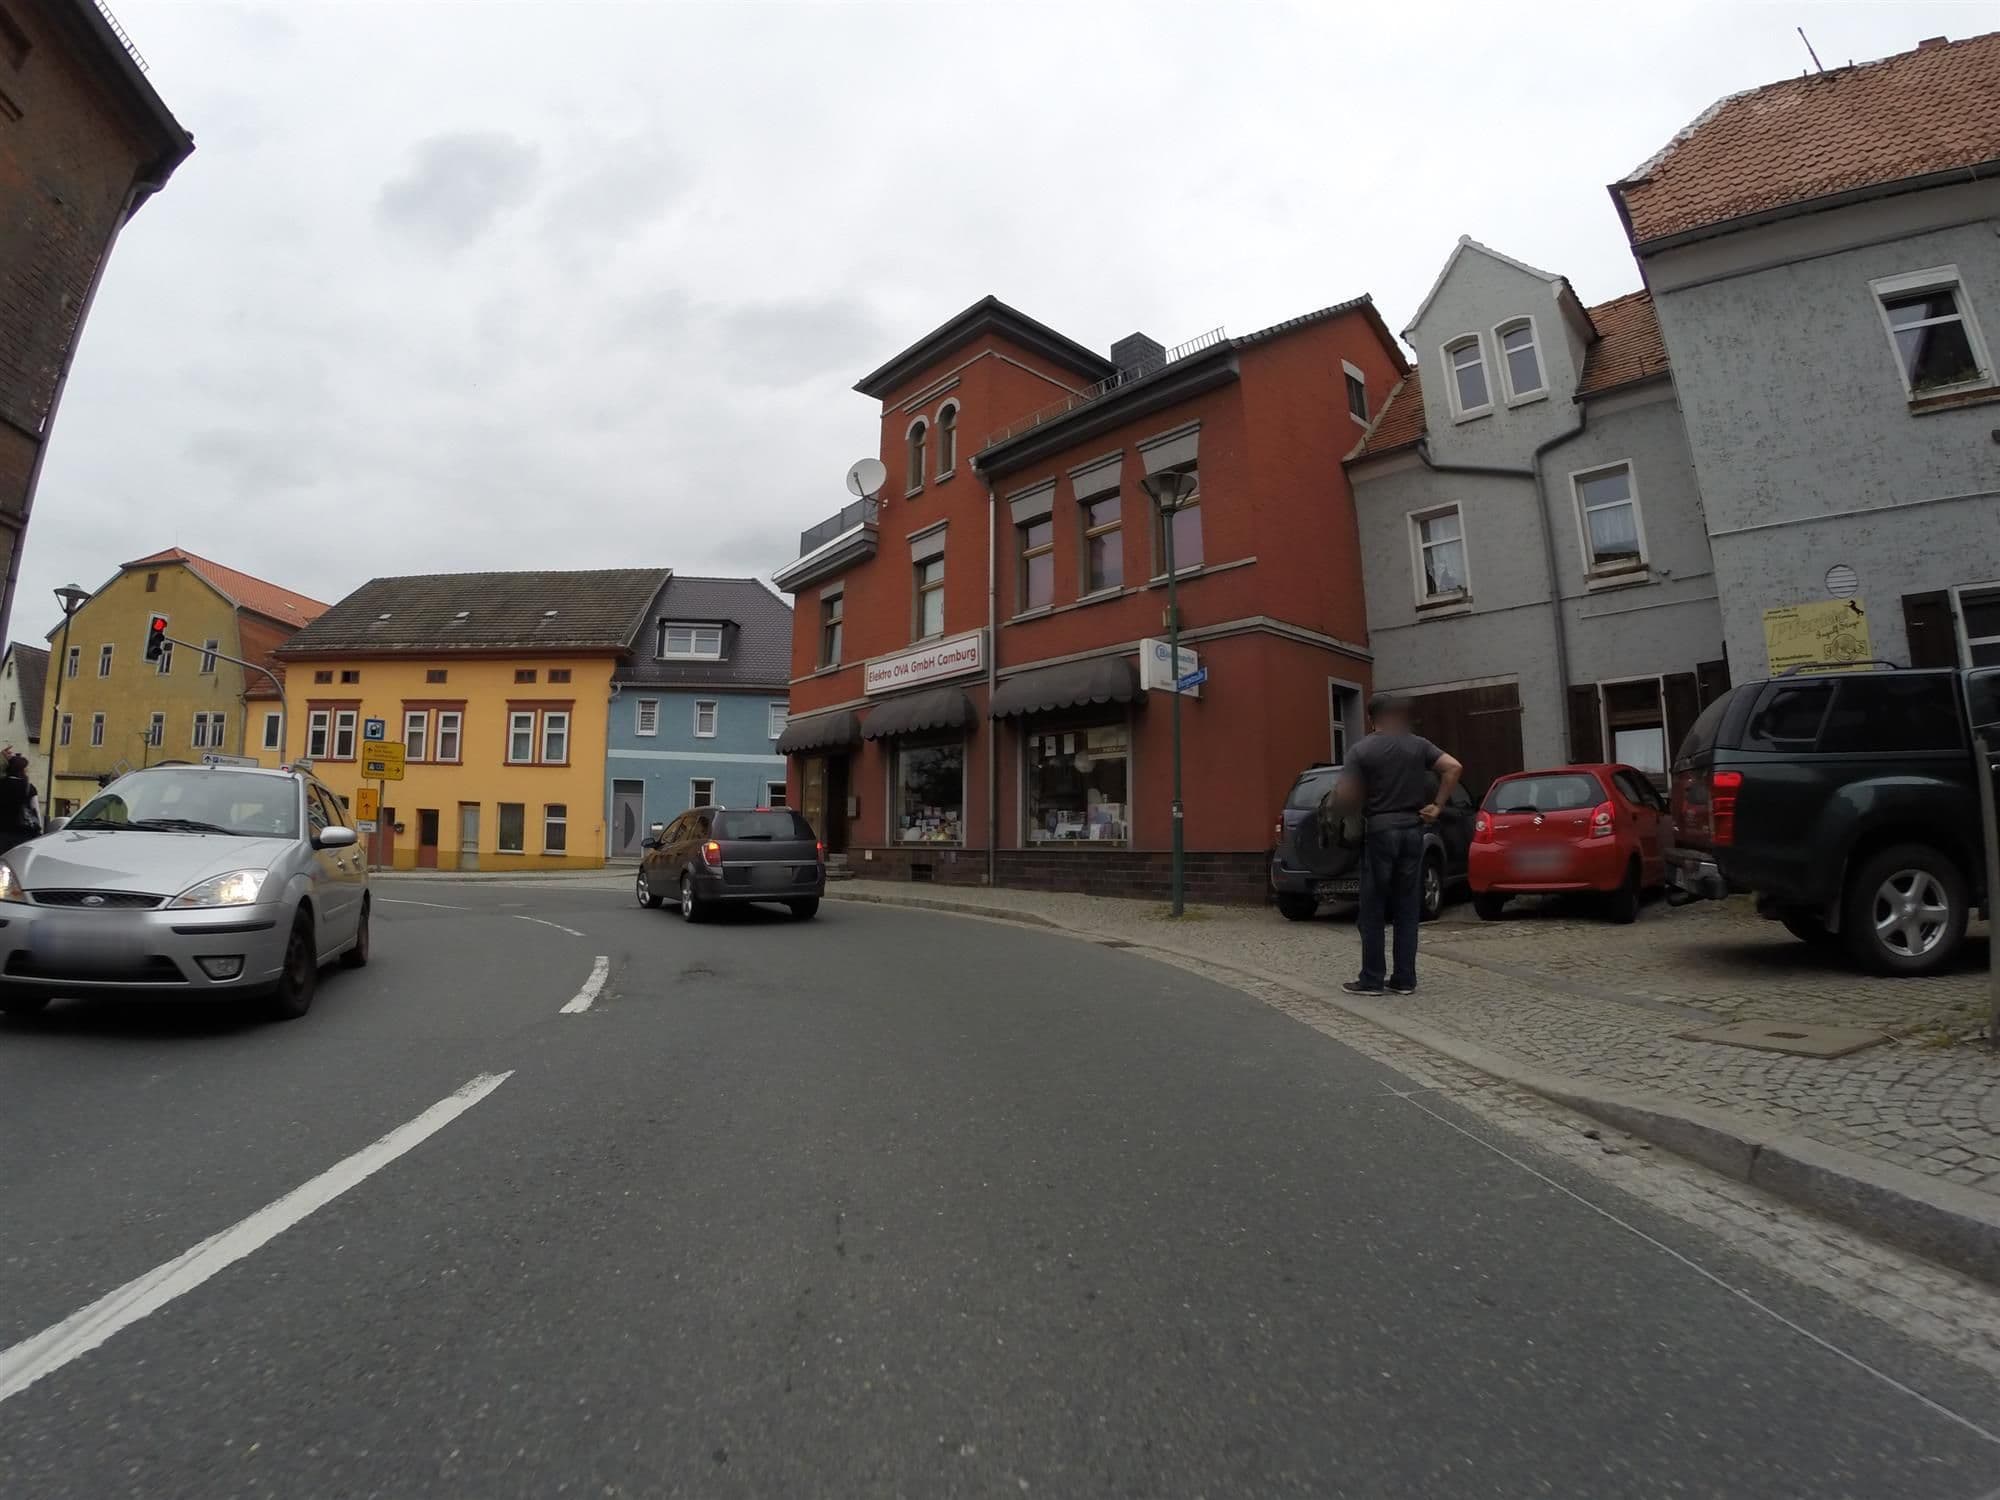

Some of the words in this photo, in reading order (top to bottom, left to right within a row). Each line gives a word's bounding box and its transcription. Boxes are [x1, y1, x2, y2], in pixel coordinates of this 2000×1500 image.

[869, 669, 892, 682] Elektro
[893, 664, 909, 677] OVA
[911, 660, 935, 673] GmbH
[938, 648, 976, 665] Camburg
